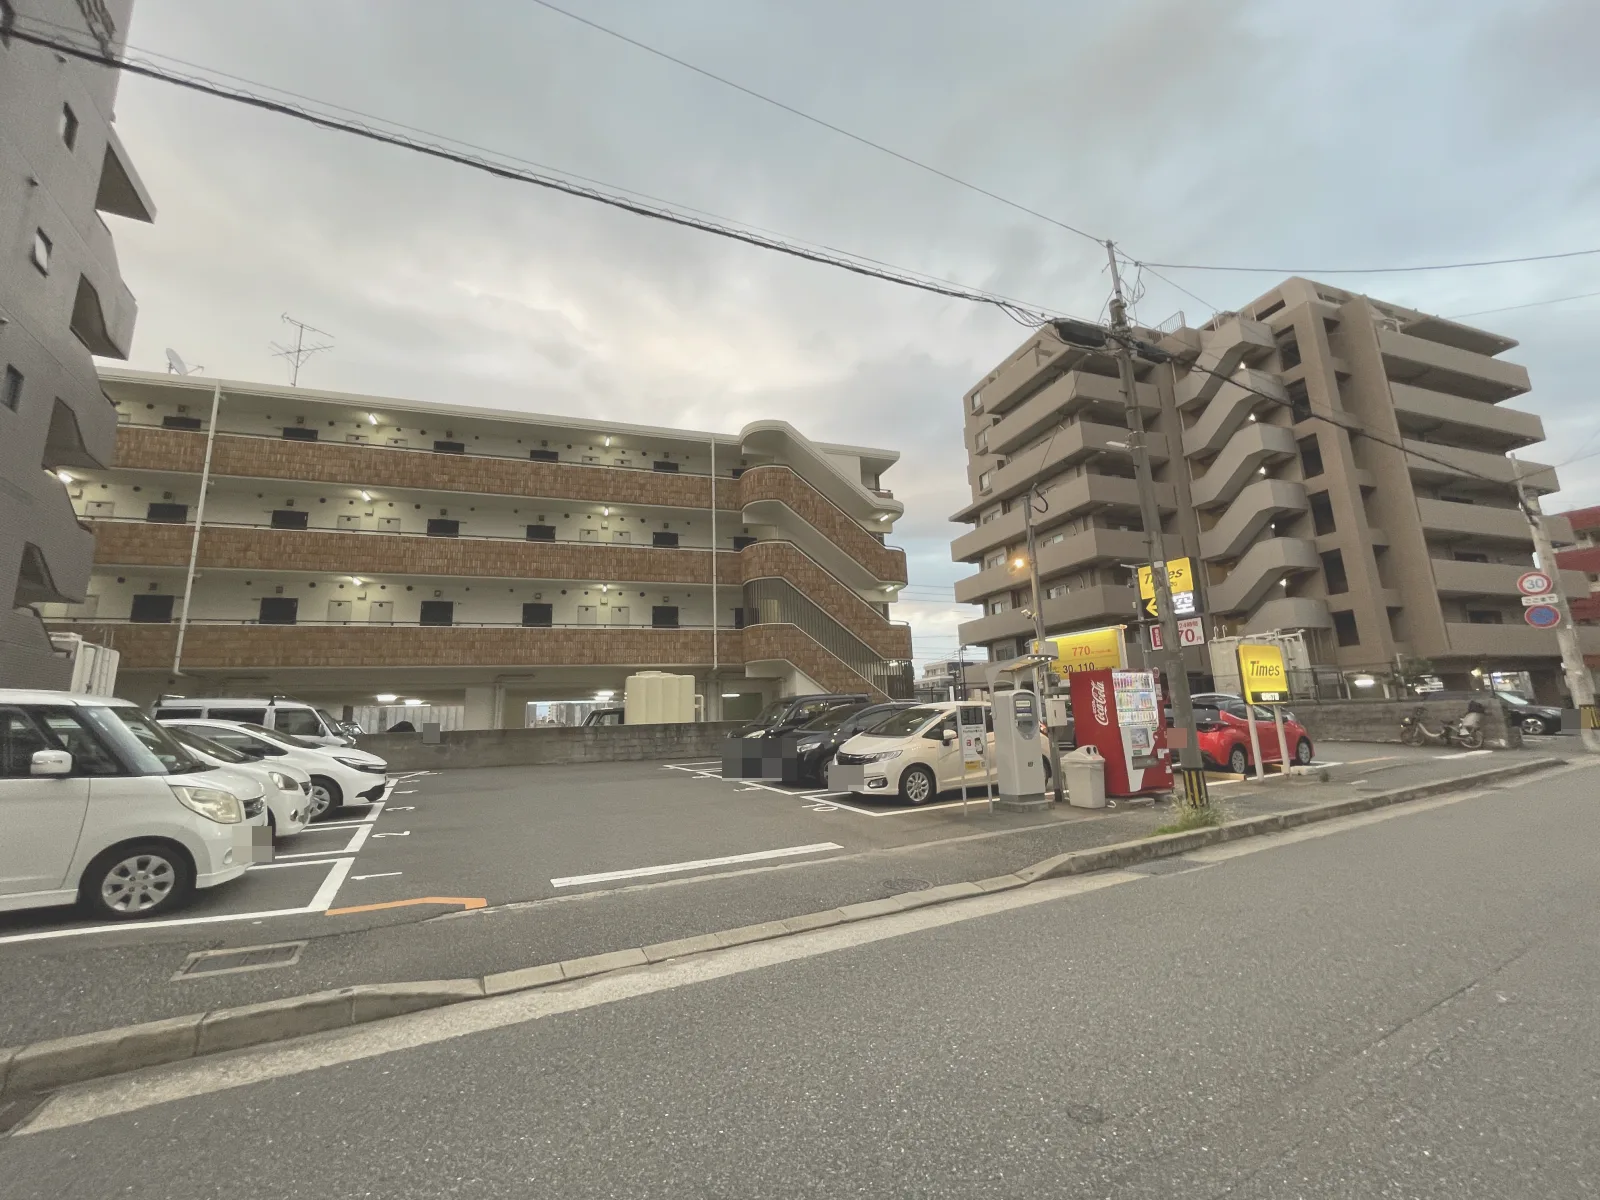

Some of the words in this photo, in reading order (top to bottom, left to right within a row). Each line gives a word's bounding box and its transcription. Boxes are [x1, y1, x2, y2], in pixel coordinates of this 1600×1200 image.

[1144, 568, 1184, 585] Tes
[1526, 578, 1545, 590] 30
[1072, 645, 1091, 657] 770
[1250, 660, 1280, 677] Times
[1090, 680, 1109, 726] Coca-Cola
